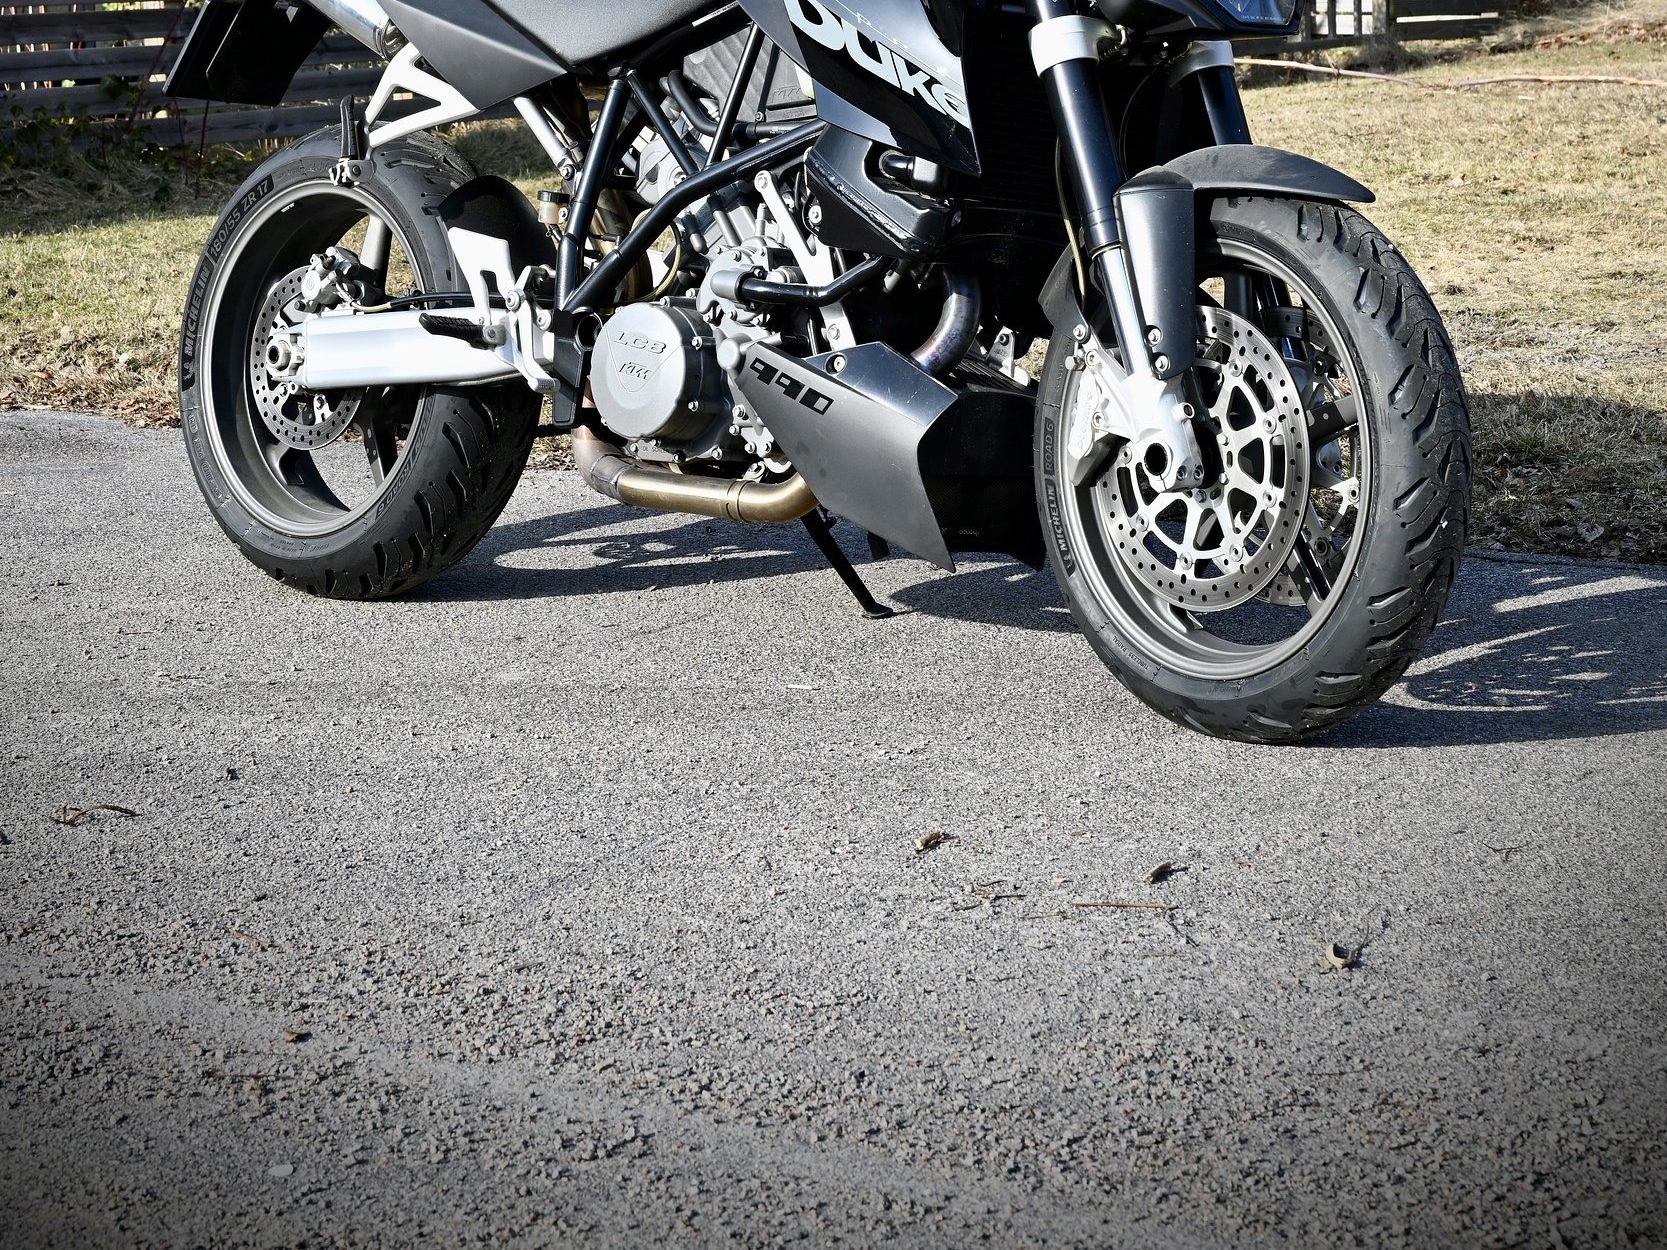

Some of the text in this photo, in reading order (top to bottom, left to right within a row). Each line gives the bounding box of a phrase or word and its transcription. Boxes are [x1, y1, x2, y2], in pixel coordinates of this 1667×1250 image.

[184, 181, 268, 357] MICHELIN 180/55 ZR 17
[613, 330, 667, 354] LC8
[619, 362, 652, 380] KTM
[749, 357, 834, 415] 990
[378, 466, 411, 516] ROAD 6
[1045, 422, 1069, 551] MICHELIN ROAD 6
[1113, 636, 1127, 653] RADIAL
